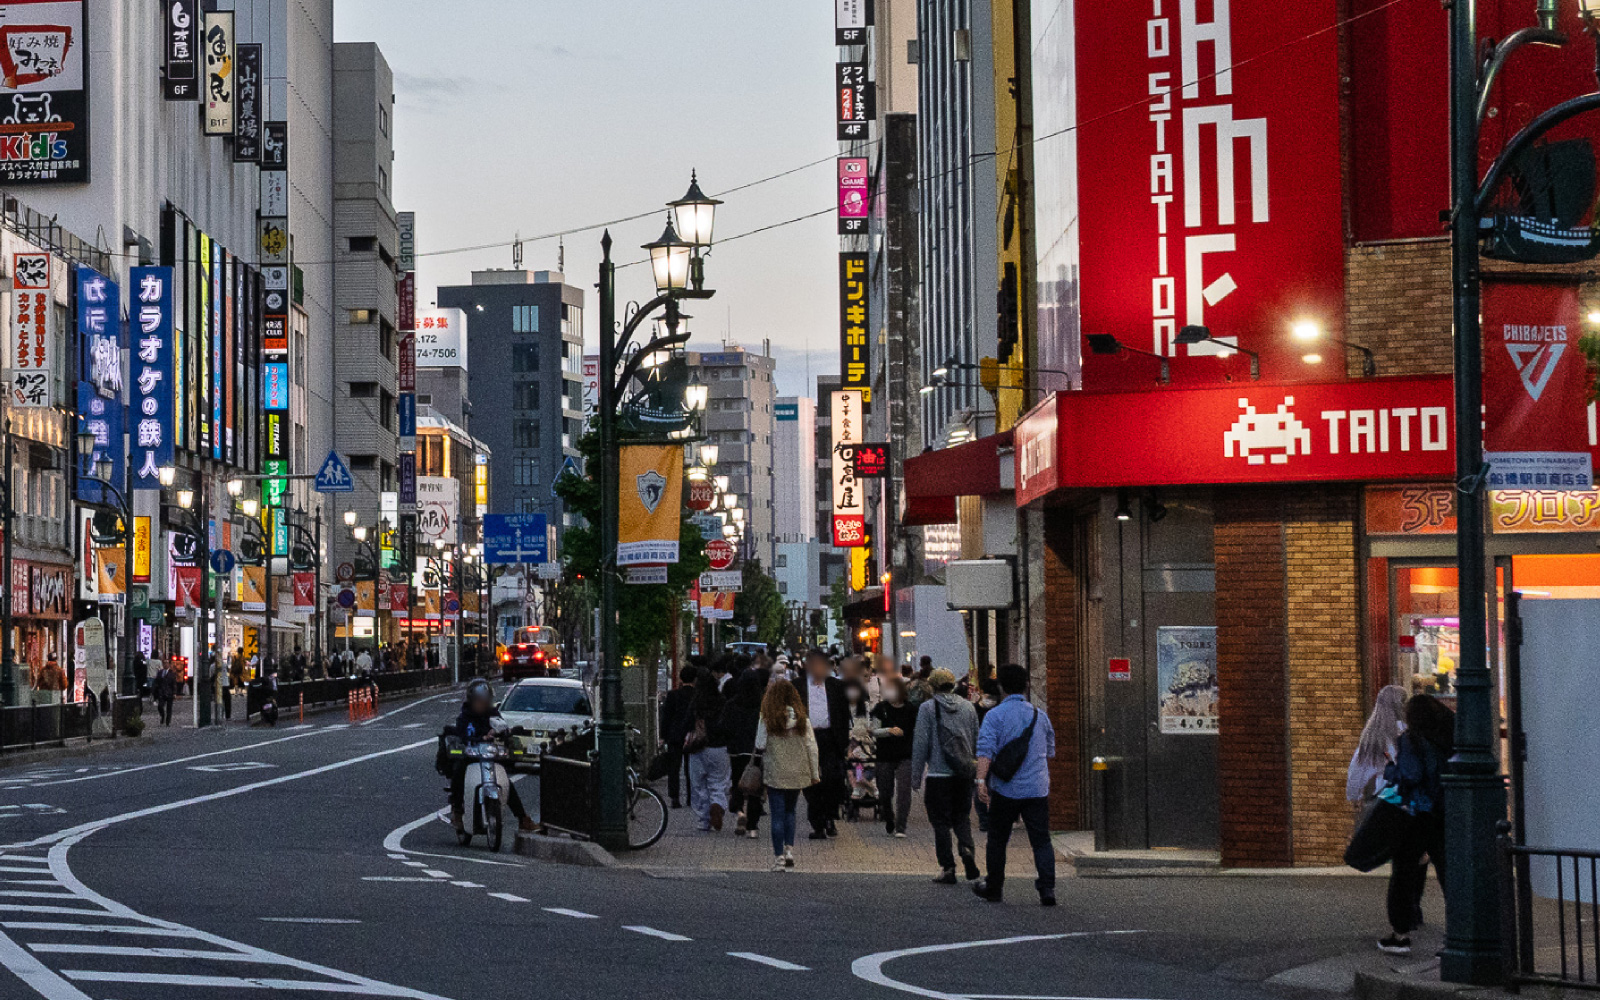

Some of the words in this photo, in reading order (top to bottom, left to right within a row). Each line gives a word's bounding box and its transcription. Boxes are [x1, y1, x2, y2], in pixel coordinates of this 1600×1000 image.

[843, 30, 859, 40] 5F
[174, 85, 188, 95] 6F
[239, 64, 257, 138] 山内農場
[210, 118, 228, 127] B1F
[845, 125, 861, 135] 4F
[841, 177, 865, 185] GAME
[846, 220, 862, 230] 3F
[1148, 72, 1176, 357] STATION
[400, 223, 413, 264] POLUS
[846, 259, 866, 383] ドン・キホーテ
[138, 274, 163, 480] カラオケの鉄人
[1320, 407, 1447, 454] TAITO
[1489, 472, 1588, 485] 船橋駅前商店会
[416, 508, 450, 530] JAPAN
[1401, 486, 1451, 532] 3F
[1495, 489, 1600, 526] フロア
